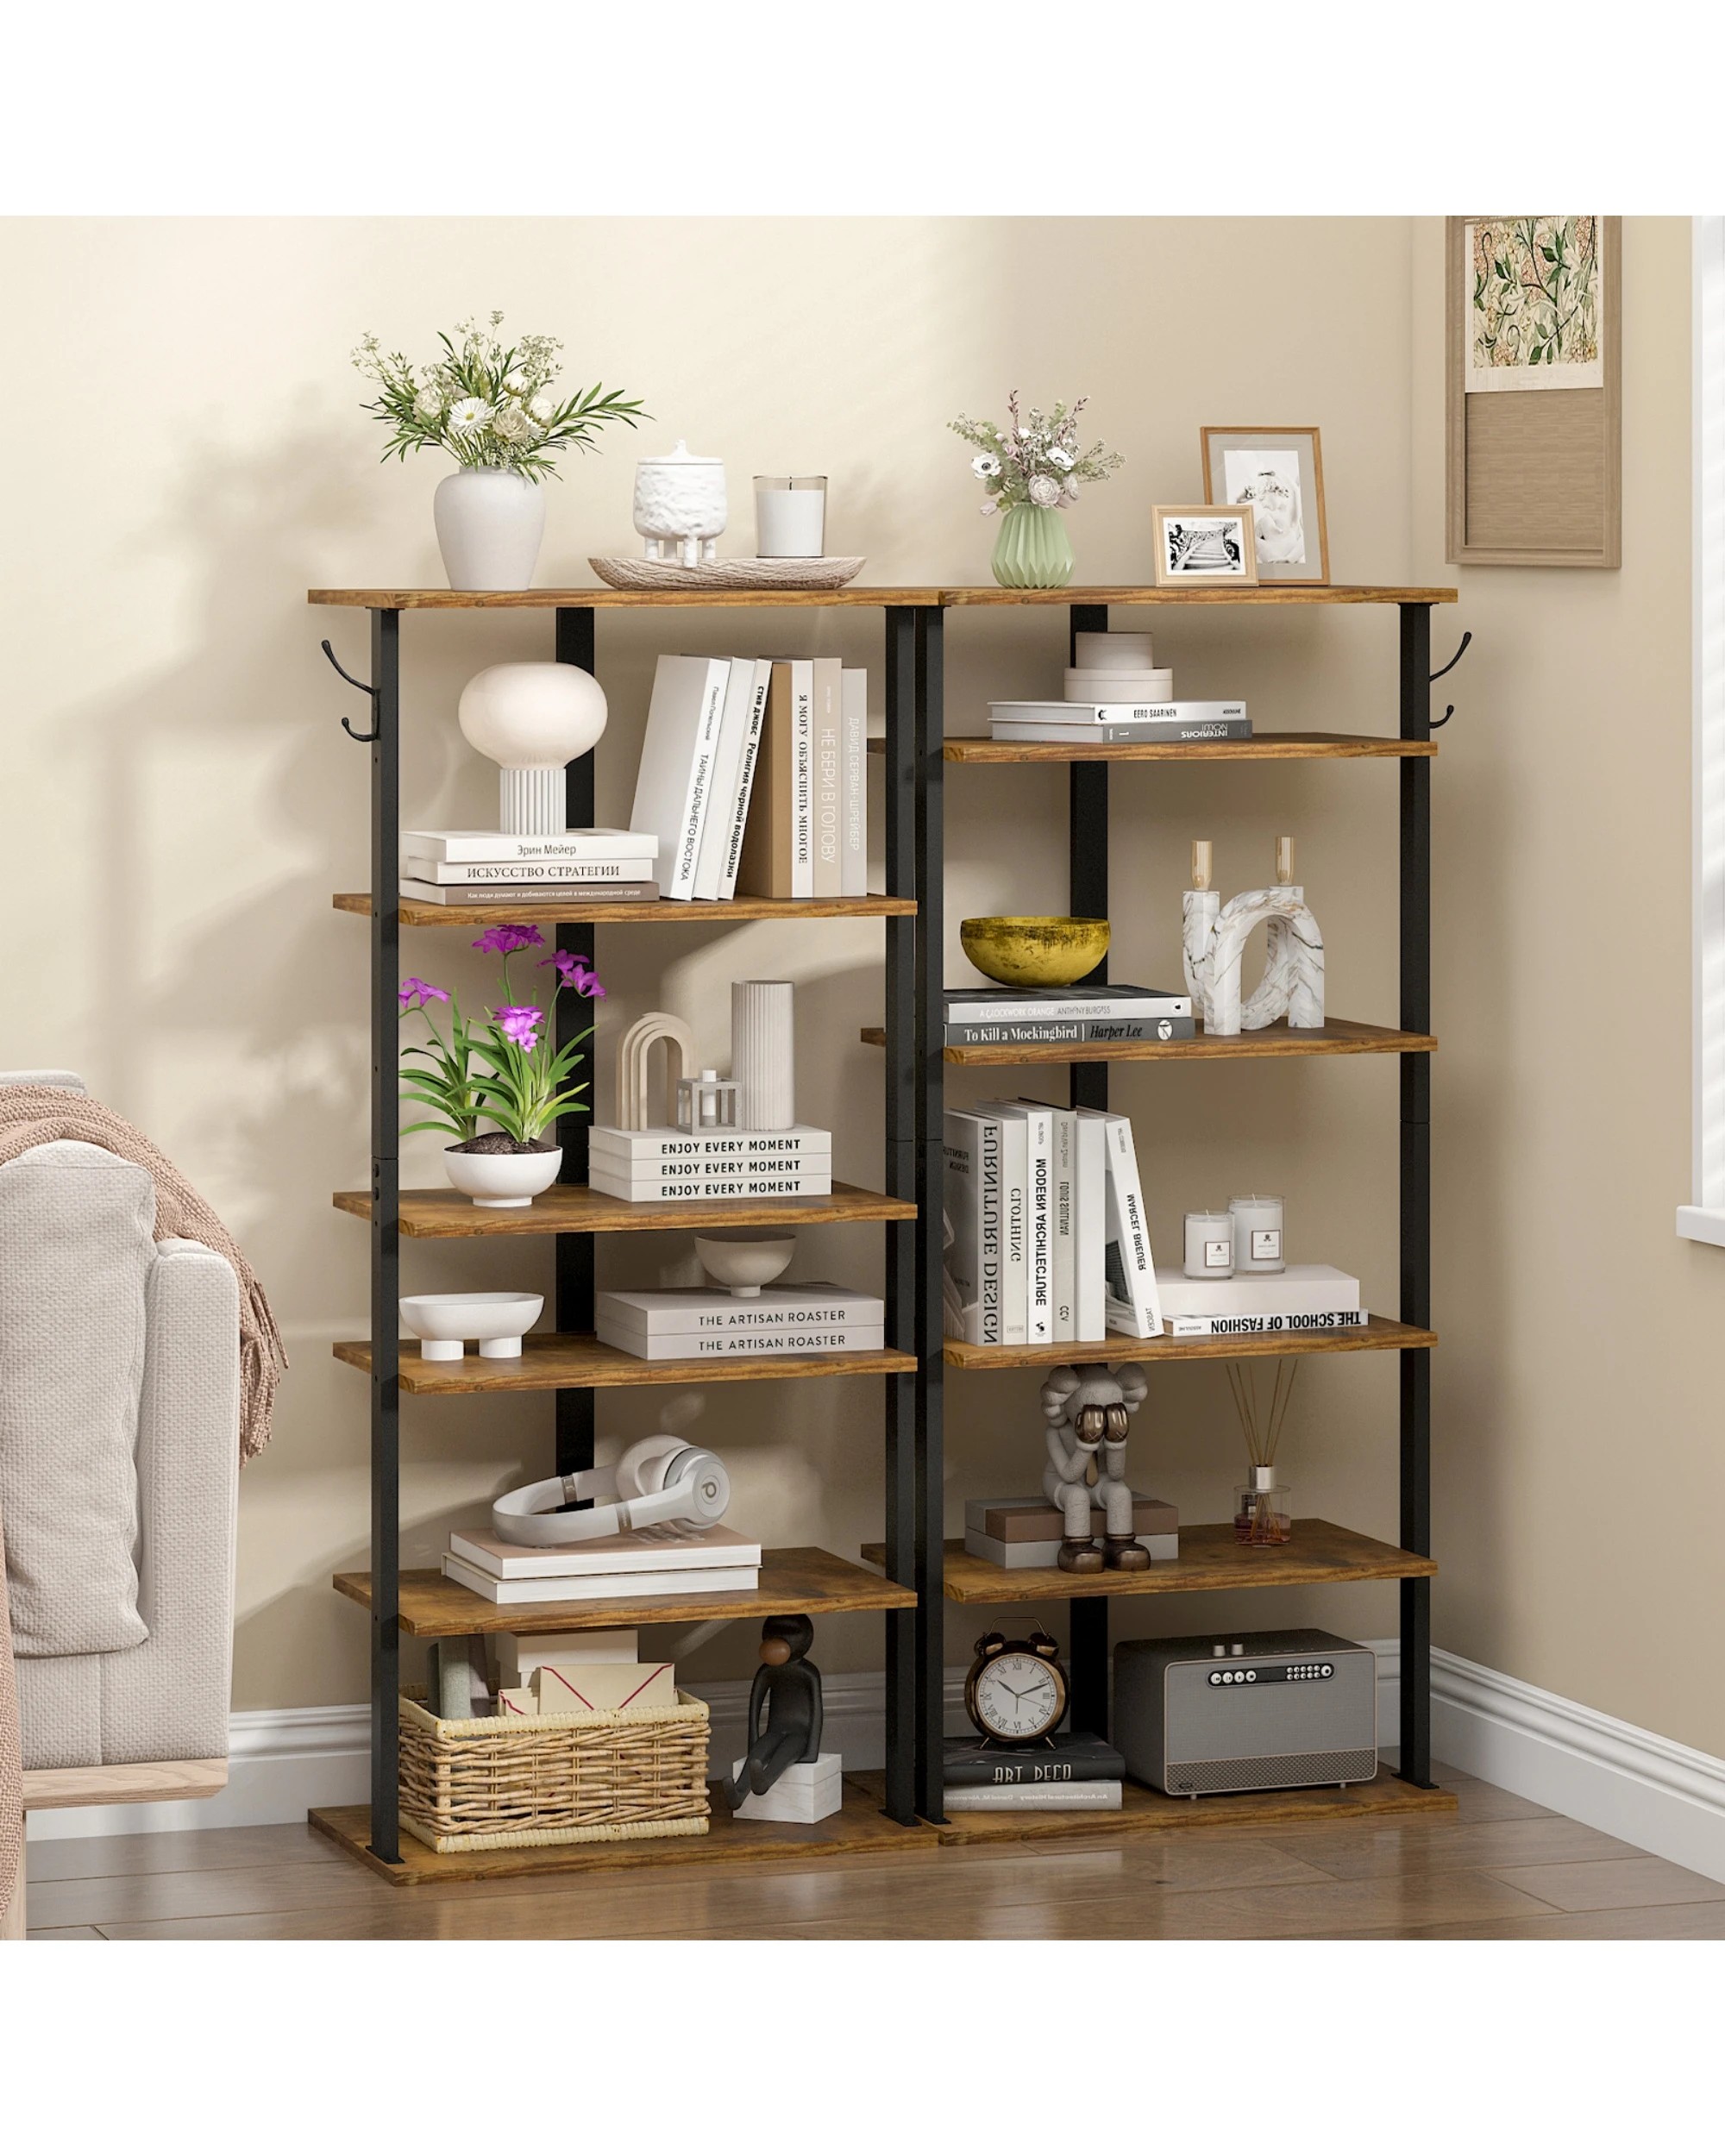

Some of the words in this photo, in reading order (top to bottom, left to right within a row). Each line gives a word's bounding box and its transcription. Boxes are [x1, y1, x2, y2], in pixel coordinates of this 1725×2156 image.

[799, 705, 807, 736] МОГУ
[1133, 709, 1147, 718] EERO
[1150, 708, 1177, 718] SAARINEN
[821, 729, 836, 746] НЕ
[849, 718, 859, 753] ДАВИД
[742, 743, 756, 784] Религия
[821, 751, 836, 788] БЕРИ
[799, 742, 807, 812] ОБЪЯСНИТЬ
[736, 786, 748, 823] черной
[821, 793, 836, 802] В
[850, 755, 861, 850] СЕРВАН-ШРЕЙБЕР
[687, 787, 703, 837] ДАЛЬНЕГО
[799, 815, 807, 864] МНОГОЕ
[821, 805, 836, 863] ГОЛОВУ
[518, 844, 542, 857] Эрин
[544, 844, 577, 856] Мейер
[681, 837, 695, 881] ВОСТОКА
[726, 824, 741, 878] водолазки
[467, 867, 544, 878] ИСКУССТВО
[548, 866, 619, 877] СТРАТЕГИИ
[964, 1028, 979, 1042] To
[981, 1027, 1000, 1041] Kill
[1001, 1031, 1008, 1041] a
[1010, 1025, 1077, 1042] Mockingbird
[1090, 1025, 1123, 1040] Harper
[1126, 1025, 1143, 1037] Lee
[662, 1143, 700, 1155] ENJOY
[706, 1141, 743, 1153] EVERY
[749, 1139, 800, 1151] MOMENT
[662, 1163, 700, 1175] ENJOY
[706, 1162, 743, 1174] EVERY
[749, 1160, 800, 1172] MOMENT
[662, 1185, 700, 1197] ENJOY
[706, 1183, 743, 1195] EVERY
[749, 1181, 800, 1193] MOMENT
[699, 1315, 723, 1326] THE
[729, 1313, 783, 1325] ARTISAN
[788, 1310, 845, 1322] ROASTER
[1211, 1318, 1264, 1333] FASHION
[1267, 1316, 1283, 1330] OF
[1286, 1313, 1334, 1328] SCHOOL
[1338, 1312, 1361, 1326] THE
[699, 1340, 723, 1351] THE
[729, 1338, 783, 1350] ARTISAN
[788, 1335, 845, 1347] ROASTER
[993, 1766, 1023, 1783] ART
[1034, 1764, 1072, 1782] DECO
